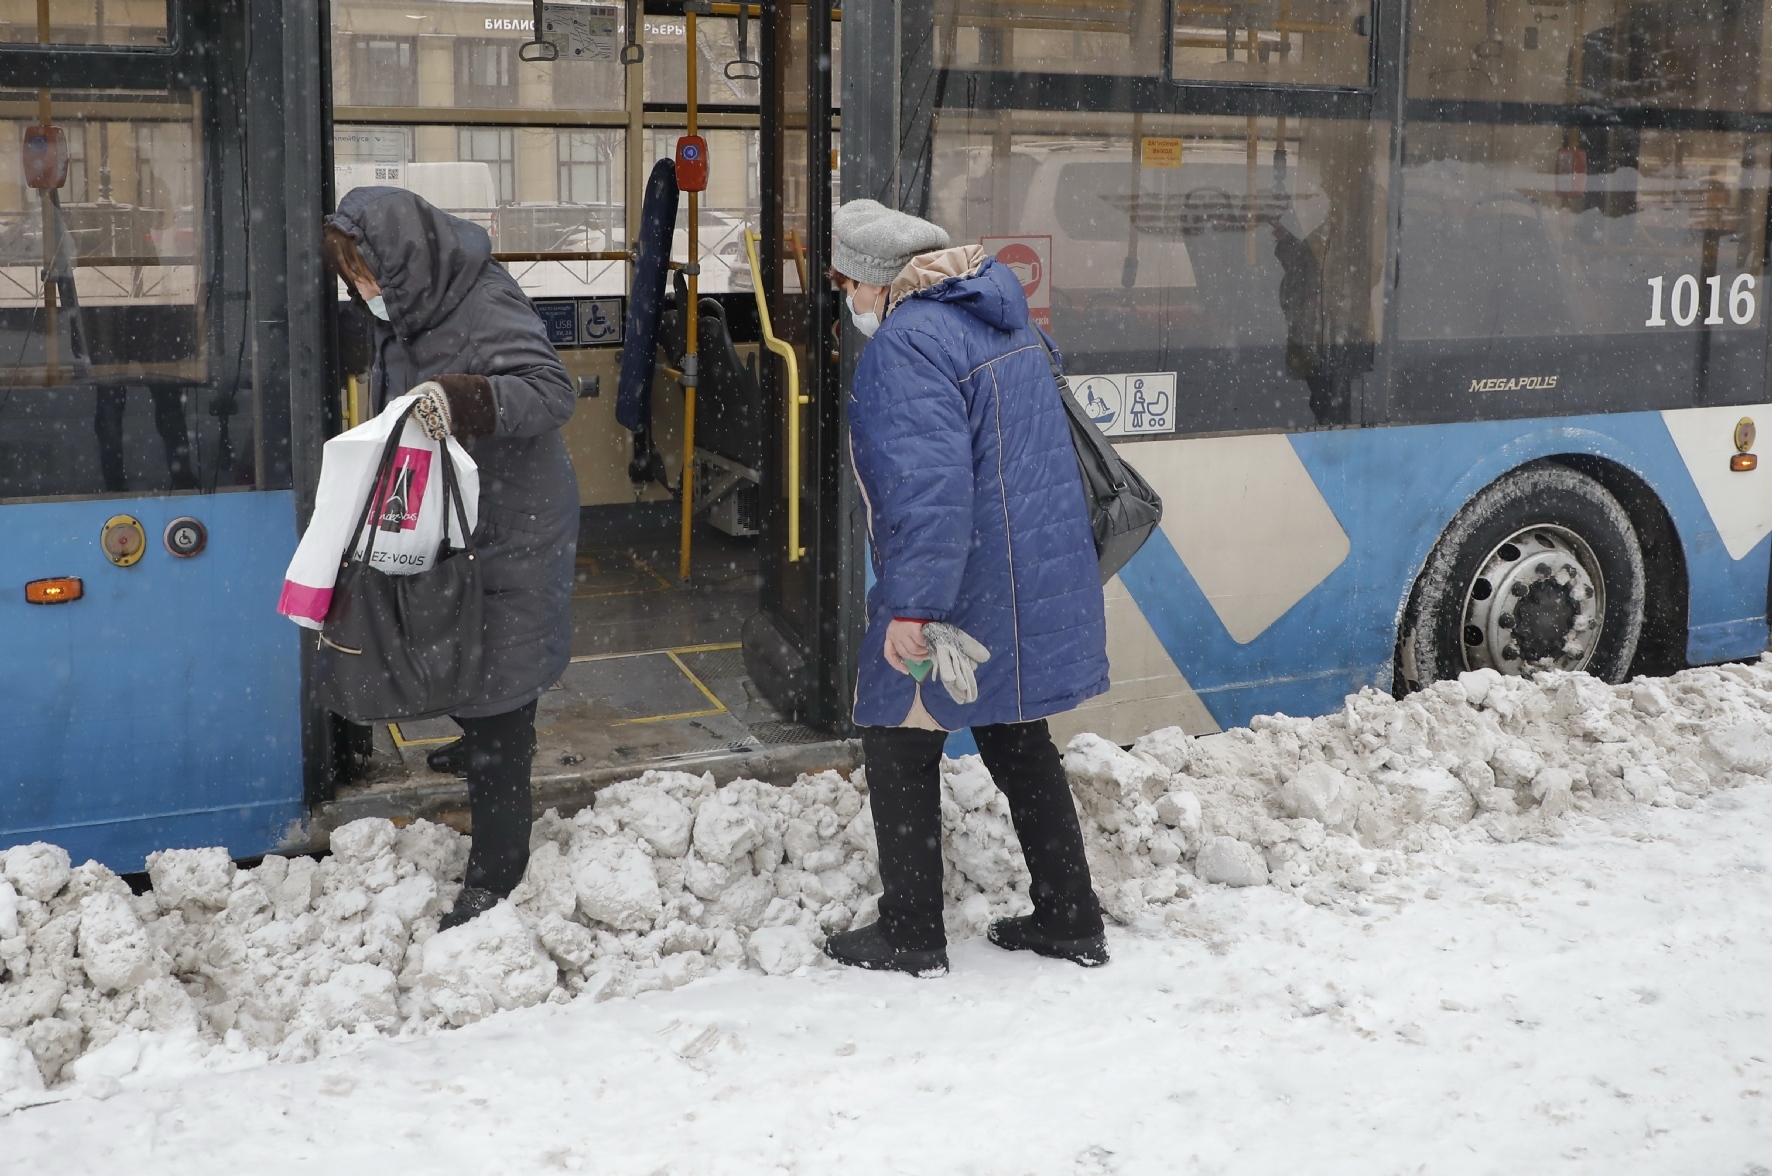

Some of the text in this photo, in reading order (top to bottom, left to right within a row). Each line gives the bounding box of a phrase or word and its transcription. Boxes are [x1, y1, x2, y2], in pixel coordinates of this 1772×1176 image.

[644, 24, 686, 35] РЬЕРЫ
[1645, 272, 1756, 327] 1016
[555, 320, 572, 329] USB
[1468, 376, 1557, 392] MEGAPOLIS
